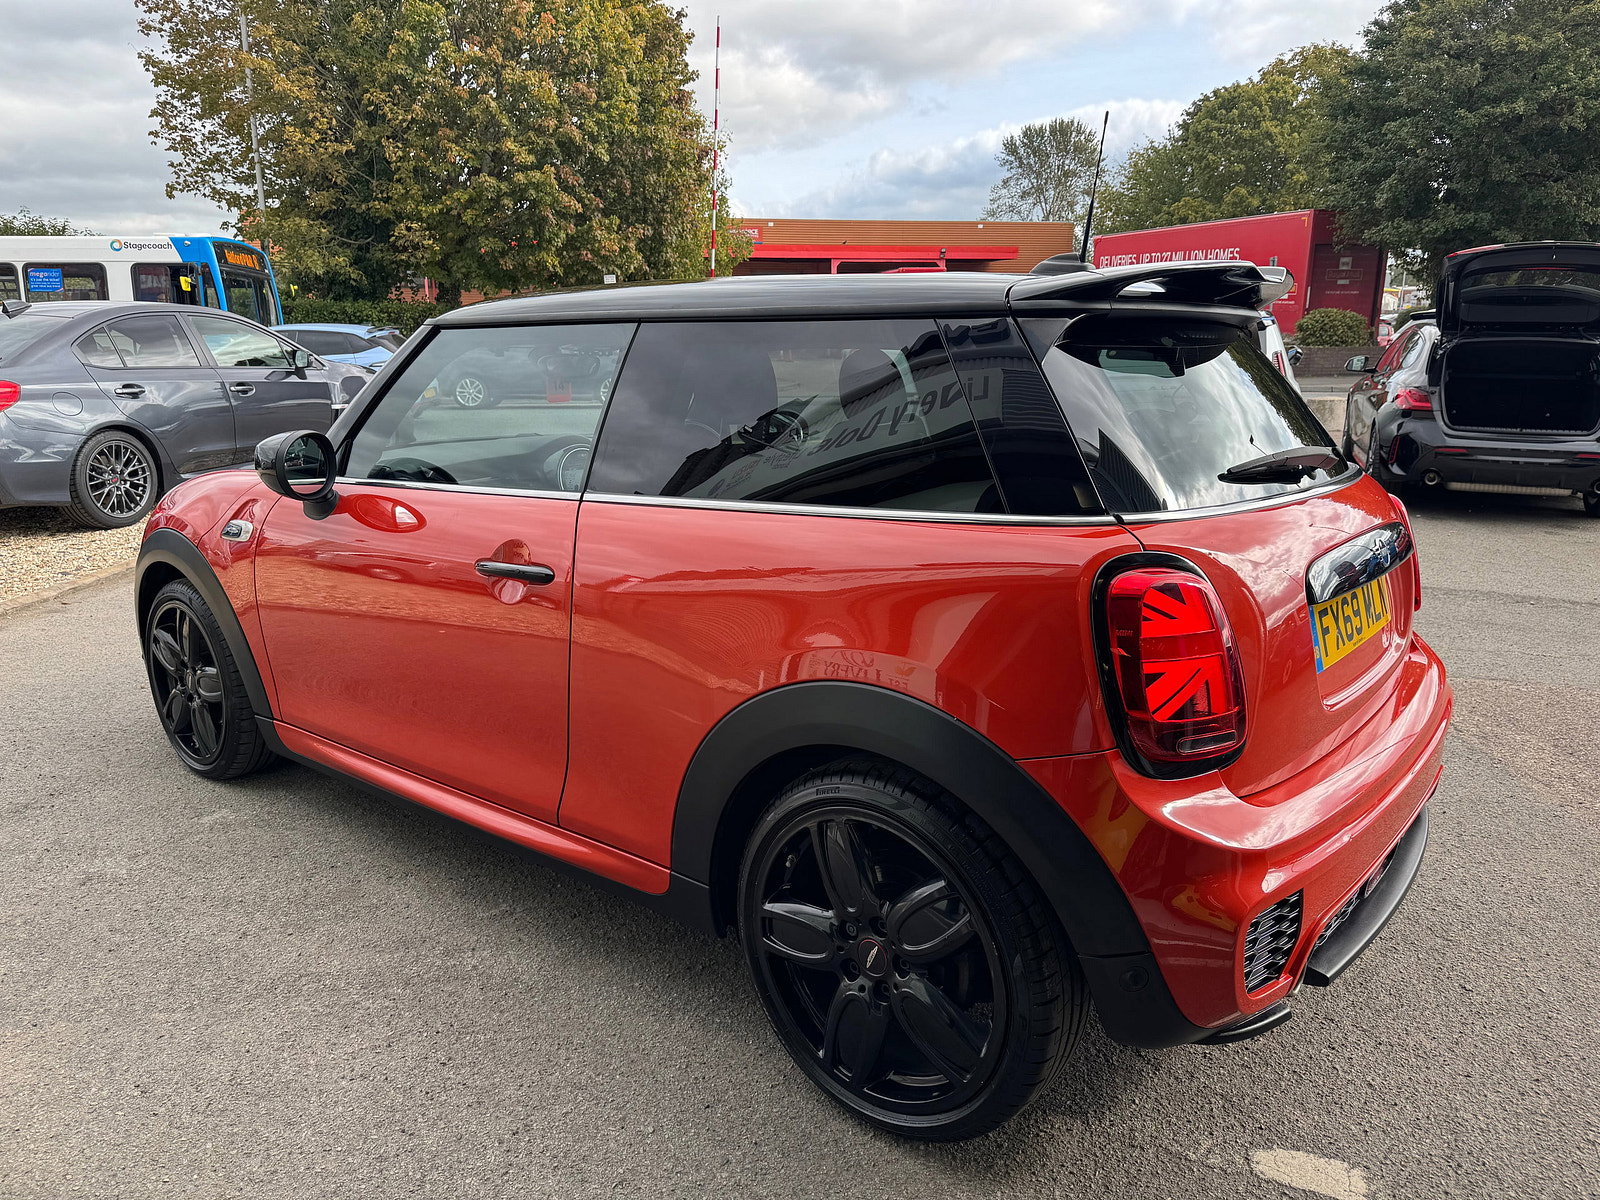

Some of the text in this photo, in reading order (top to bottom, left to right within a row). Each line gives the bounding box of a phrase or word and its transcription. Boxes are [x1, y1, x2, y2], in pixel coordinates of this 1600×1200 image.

[123, 241, 173, 251] Stagecoach
[1140, 253, 1150, 265] UP
[1151, 252, 1161, 263] TO
[1161, 252, 1171, 262] 27
[1172, 249, 1206, 261] MILLION
[1318, 578, 1389, 658] FX69 MLN
